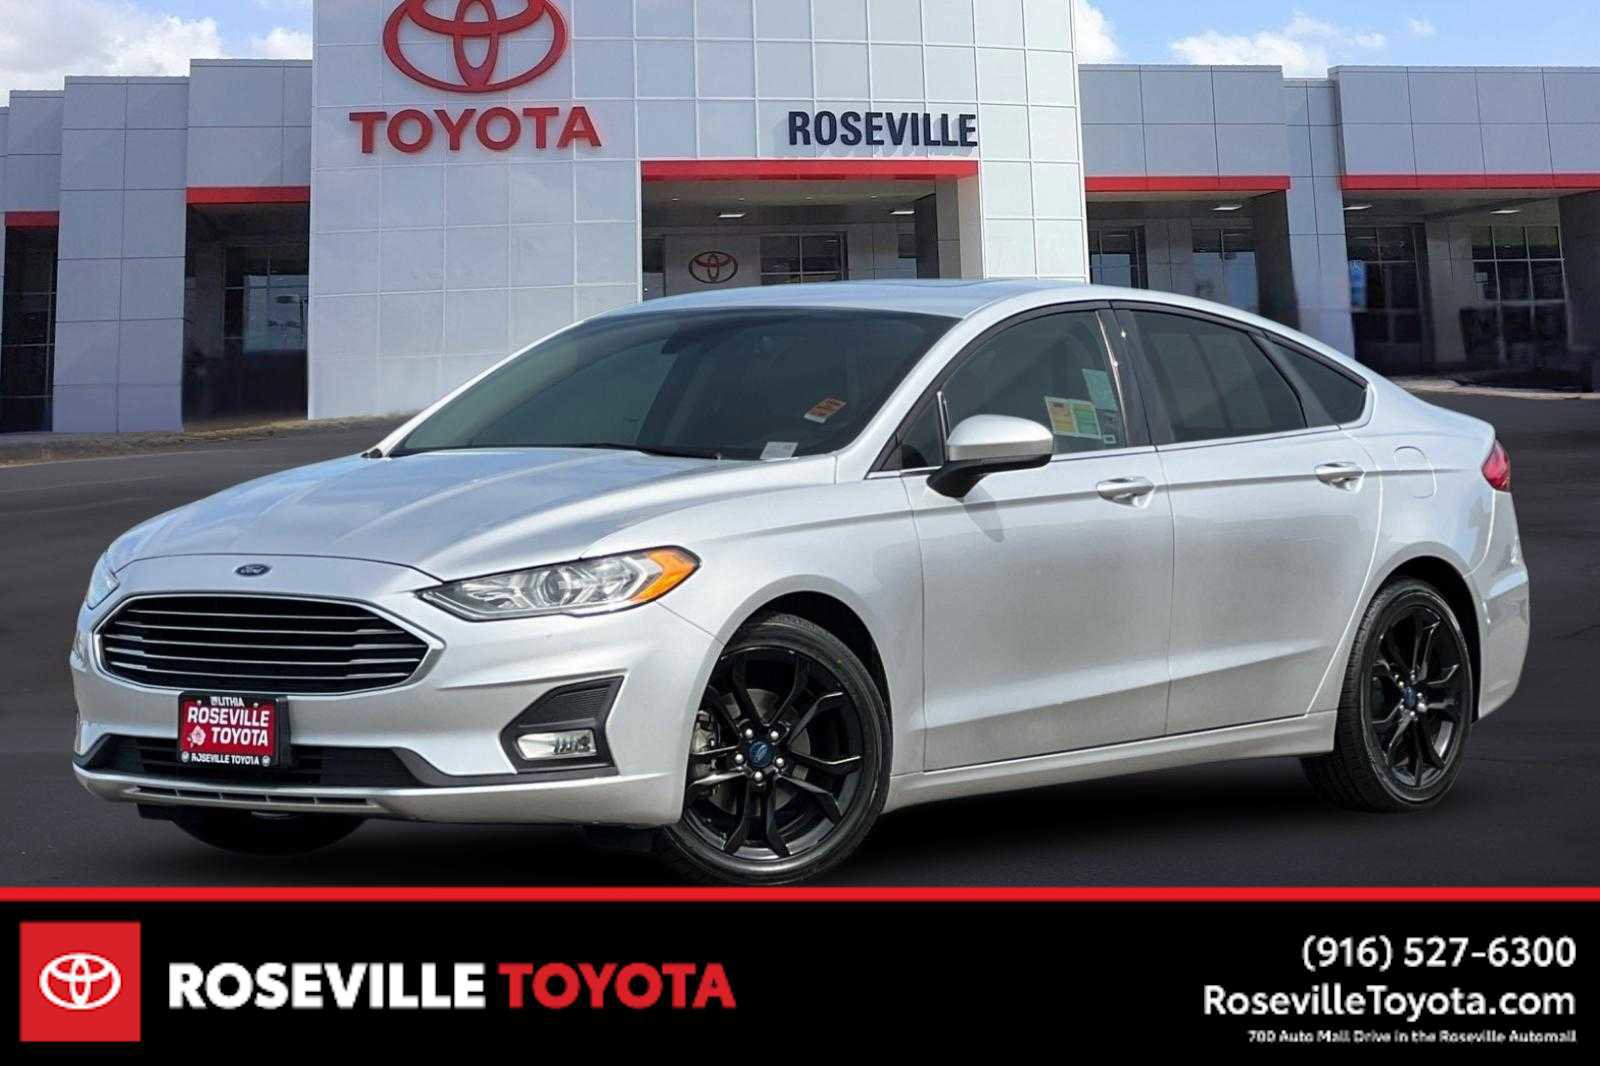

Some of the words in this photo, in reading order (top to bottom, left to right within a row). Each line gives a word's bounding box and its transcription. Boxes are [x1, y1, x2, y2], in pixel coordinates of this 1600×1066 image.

[351, 106, 601, 154] TOYOTA
[789, 110, 978, 147] ROSEVILLE
[187, 706, 270, 728] ROSEVILLE
[211, 726, 269, 747] TOYOTA
